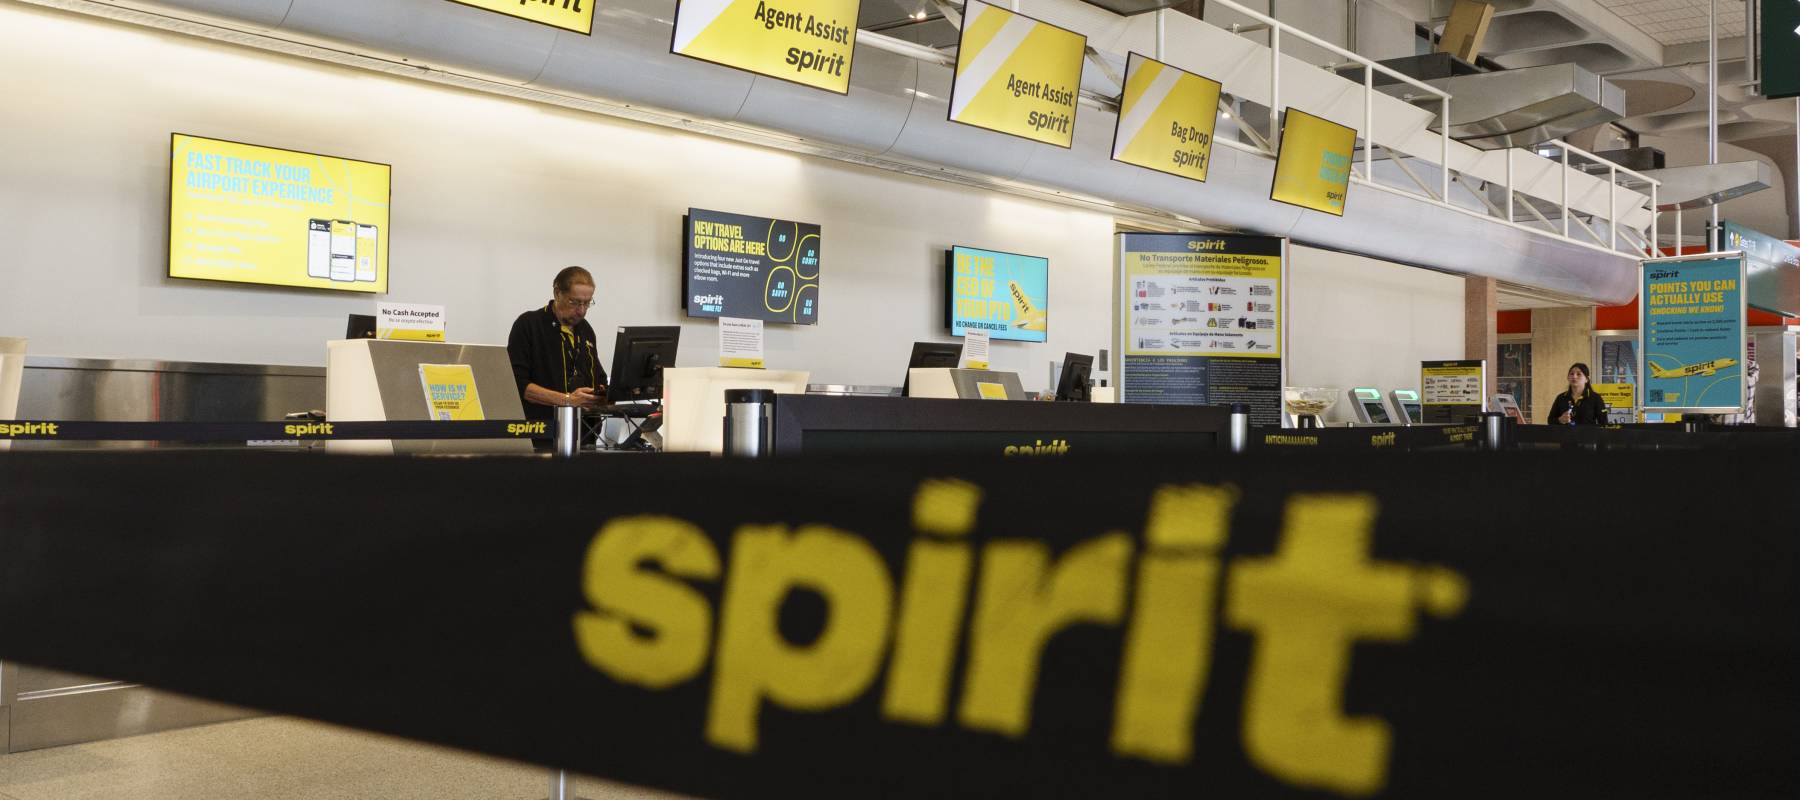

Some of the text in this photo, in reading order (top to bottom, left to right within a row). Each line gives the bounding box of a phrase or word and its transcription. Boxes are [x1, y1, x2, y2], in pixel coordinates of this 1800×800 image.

[754, 1, 849, 46] Agent Assist
[785, 46, 844, 77] spirit
[1007, 74, 1073, 107] Agent Assist
[1028, 110, 1070, 134] spirit
[1171, 121, 1208, 147] Bag Drop
[187, 151, 311, 183] FAST TRACK YOUR
[1173, 149, 1207, 169] spirit
[187, 172, 249, 194] AIRPORT
[252, 181, 334, 206] EXPERIENCE
[694, 221, 743, 239] NEW TRAVEL
[694, 235, 765, 256] OPTIONS ARE HERE
[1187, 239, 1226, 251] spirit
[694, 253, 717, 261] Introducing
[957, 254, 972, 274] BE
[1139, 254, 1150, 262] No
[1152, 255, 1193, 263] Transporte
[1233, 257, 1269, 266] Peligrosos.
[1650, 271, 1679, 280] spirit
[957, 276, 979, 296] CEO
[1650, 279, 1736, 294] POINTS YOU CAN
[694, 294, 724, 305] spirit
[1010, 283, 1029, 313] spirit
[1650, 292, 1724, 306] ACTUALLY USE
[410, 311, 440, 319] Accepted
[957, 298, 987, 320] YOUR
[984, 322, 998, 330] CANCEL
[998, 323, 1007, 331] FEES
[1684, 361, 1715, 374] spirit
[430, 384, 446, 392] HOW
[448, 384, 455, 392] IS
[0, 422, 59, 436] spirit
[285, 423, 334, 436] spirit
[507, 421, 547, 435] spirit
[1371, 431, 1396, 448] spirit
[573, 476, 1468, 794] spirit
